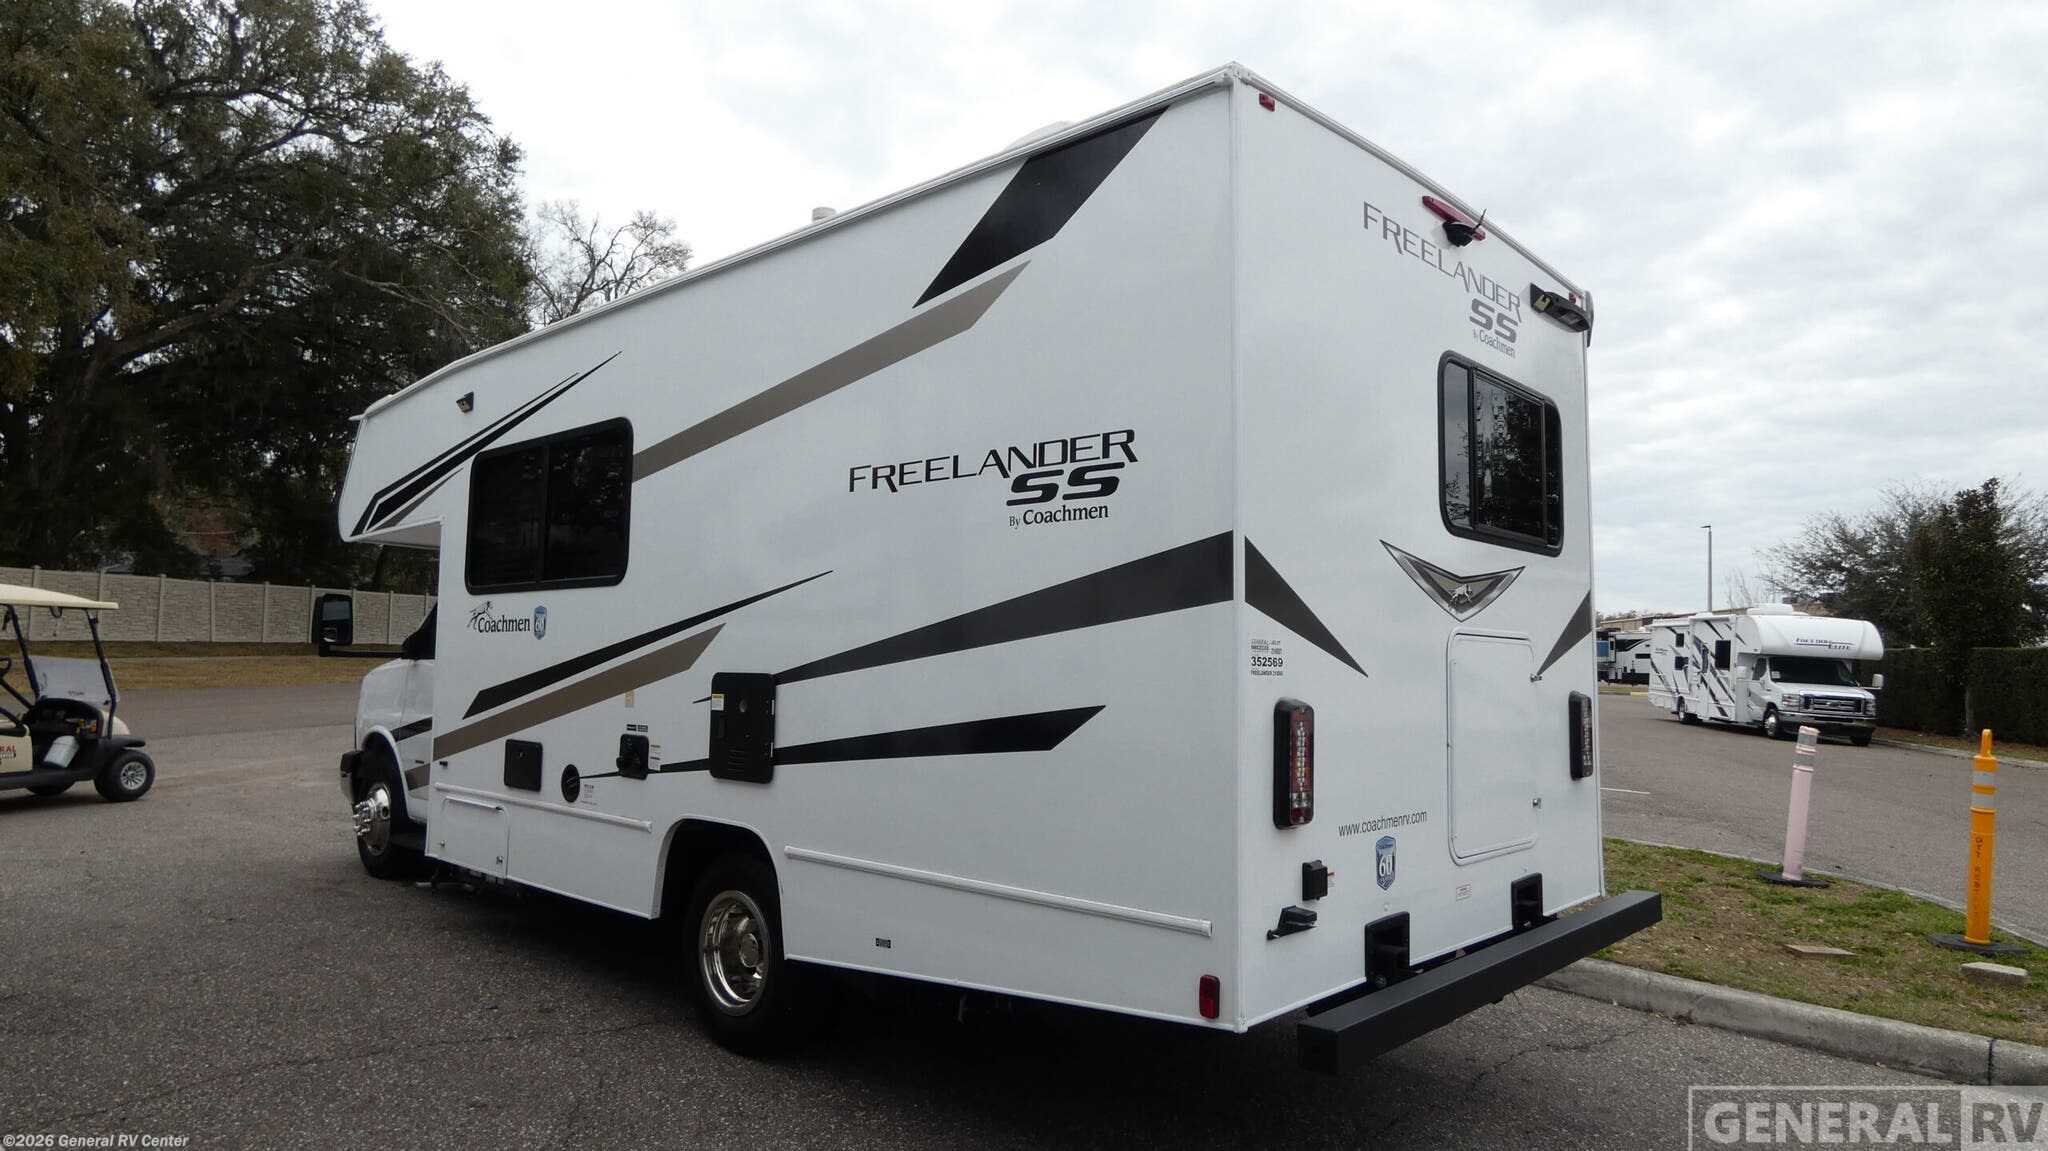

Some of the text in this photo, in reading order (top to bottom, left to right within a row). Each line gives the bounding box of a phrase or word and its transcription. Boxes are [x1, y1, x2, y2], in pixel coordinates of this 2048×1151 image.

[1363, 201, 1522, 322] FREELANDER
[1469, 298, 1518, 343] SS
[1479, 330, 1515, 358] Coachmen
[849, 429, 1139, 493] FREELANDER
[1006, 462, 1125, 506] SS
[1009, 504, 1109, 529] By Coachmen
[478, 614, 530, 633] Coachmen
[1251, 656, 1283, 667] 352569
[1338, 810, 1427, 837] www.coachmenrv.com
